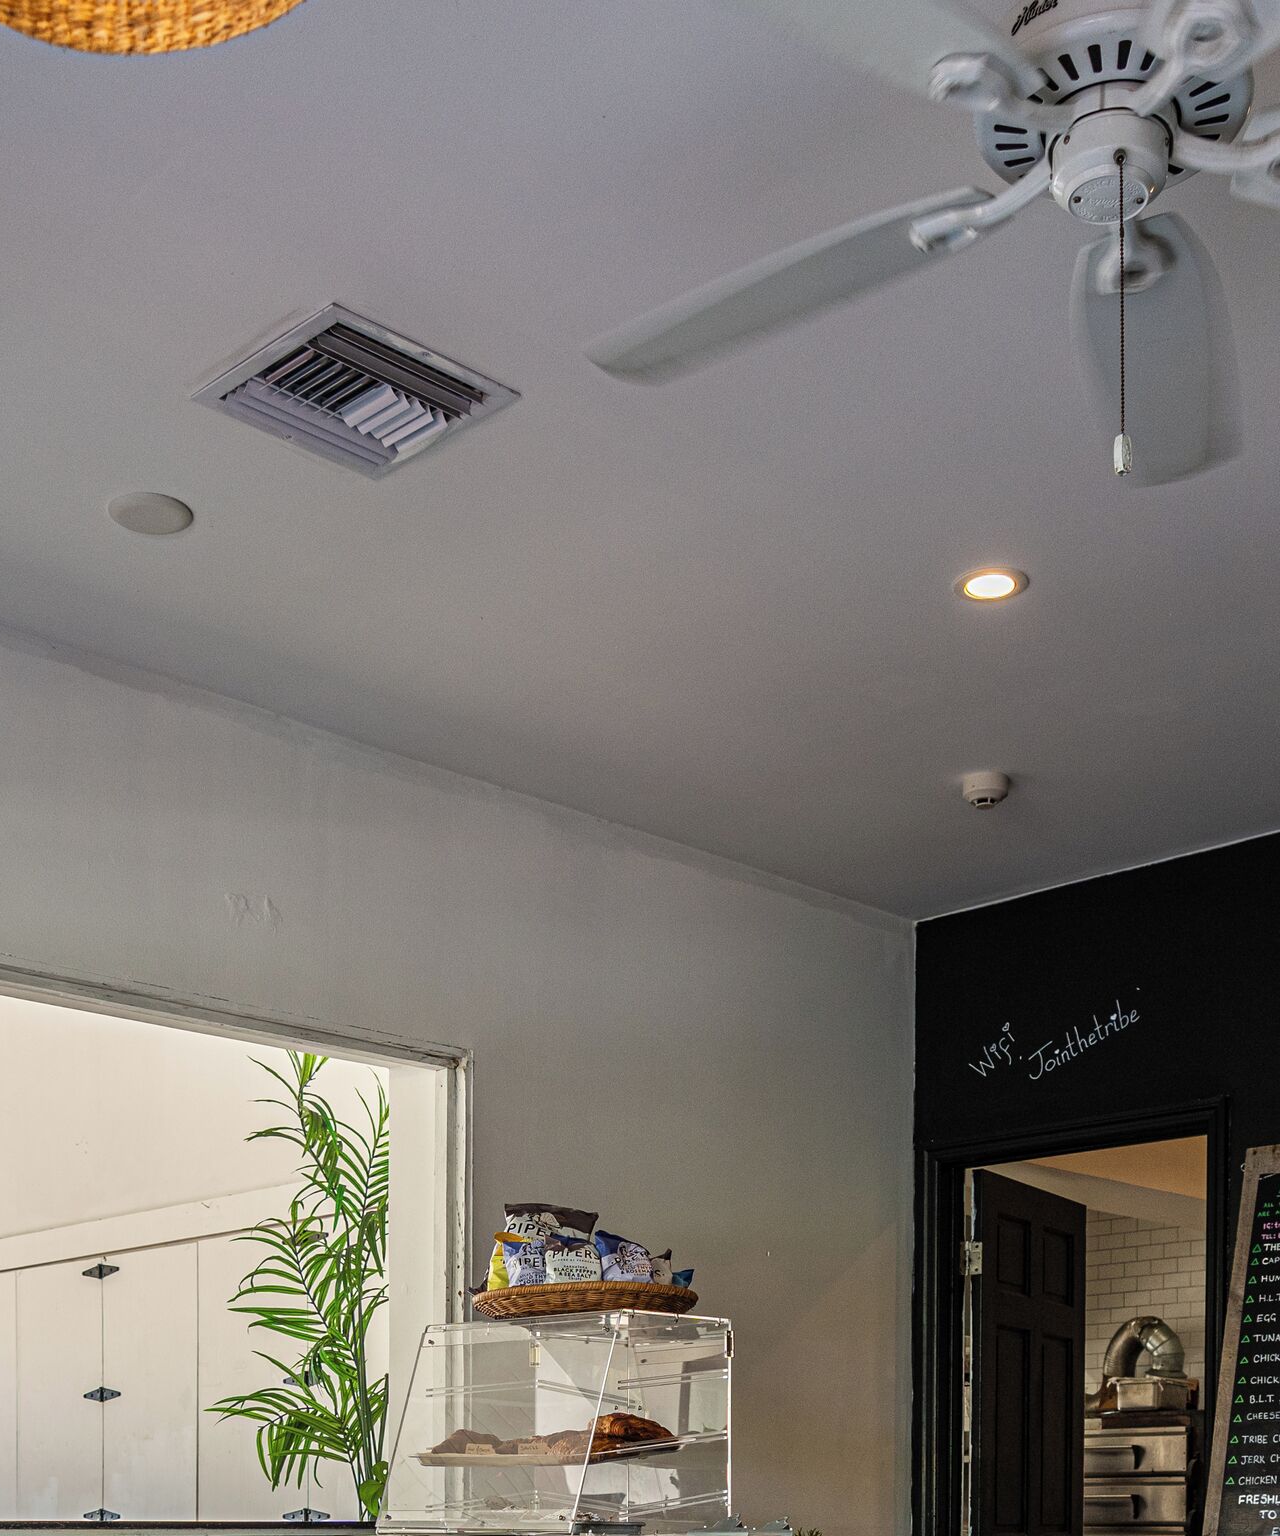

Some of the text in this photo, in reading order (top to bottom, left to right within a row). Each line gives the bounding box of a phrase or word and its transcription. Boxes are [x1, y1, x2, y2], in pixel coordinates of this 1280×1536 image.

[1029, 999, 1140, 1080] Jointhetribe
[1256, 1314, 1276, 1323] EGG
[1253, 1334, 1280, 1343] TUNA
[1242, 1435, 1268, 1444] TRIBE
[1241, 1455, 1265, 1465] JERK
[1238, 1476, 1277, 1486] CHICKEN
[1259, 1510, 1277, 1521] TO
